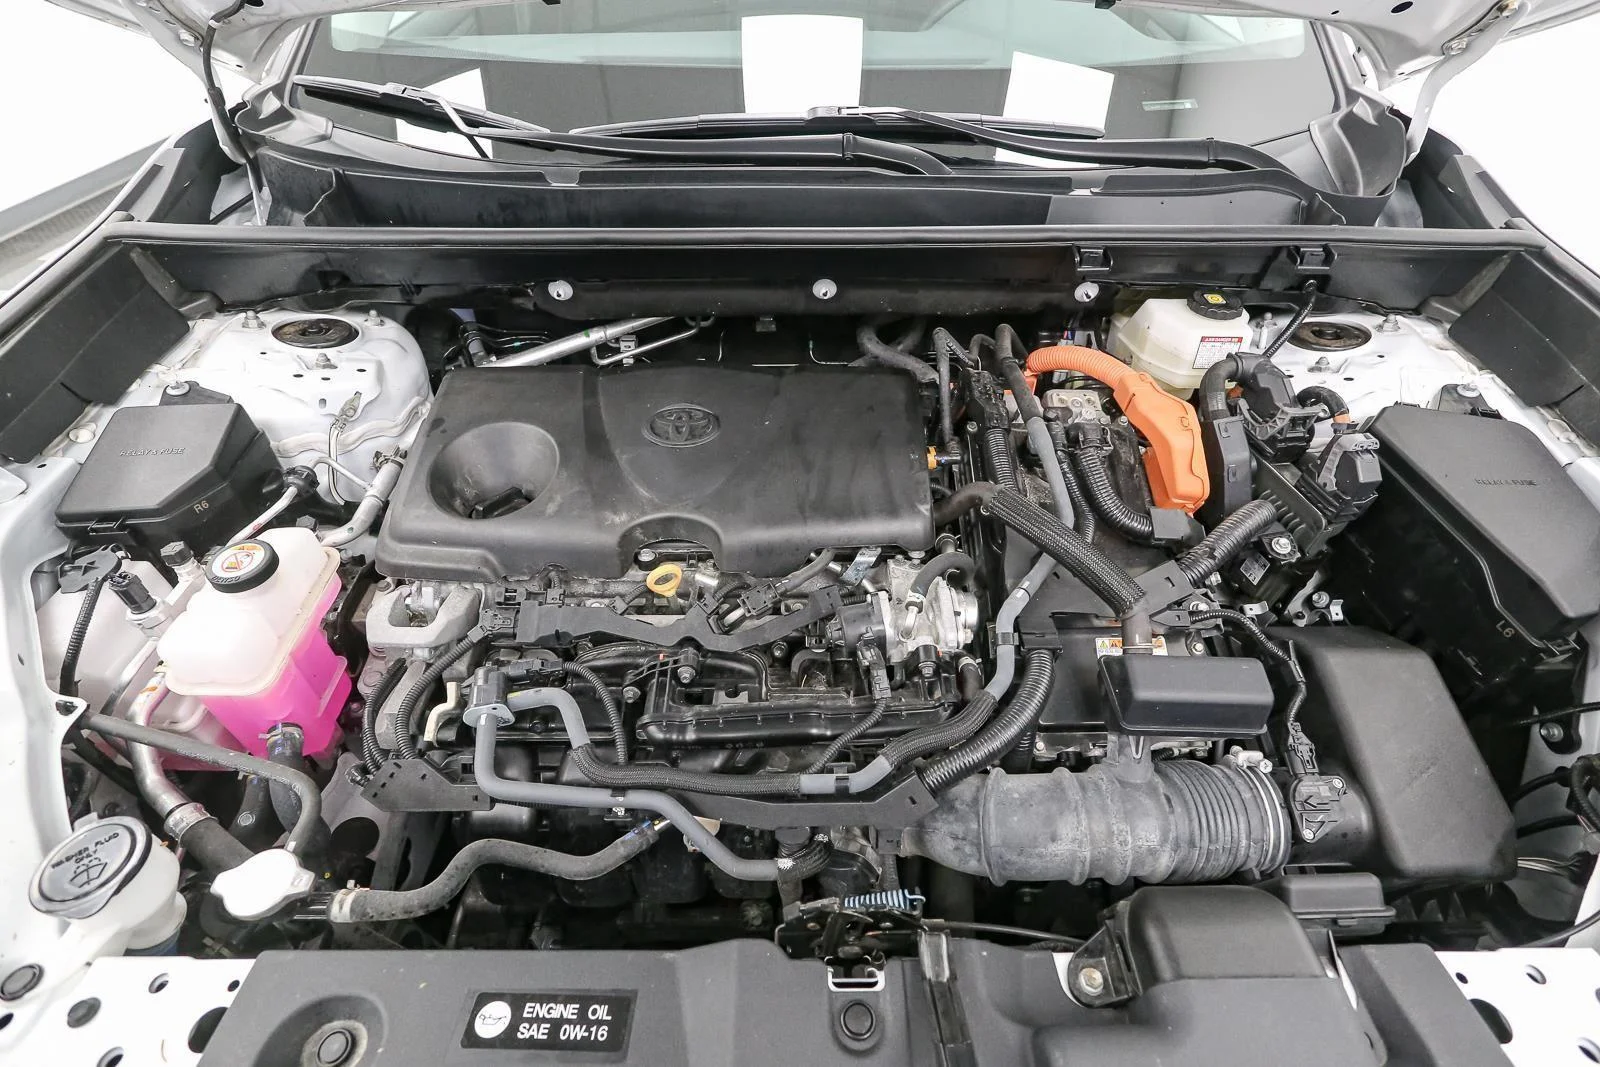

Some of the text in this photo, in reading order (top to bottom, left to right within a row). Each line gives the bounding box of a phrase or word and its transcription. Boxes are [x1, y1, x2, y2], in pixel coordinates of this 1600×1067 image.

[119, 448, 151, 457] RELAY
[160, 447, 186, 455] FUSE
[193, 500, 209, 514] R6
[1495, 619, 1516, 638] L6
[94, 832, 120, 848] FLUID
[74, 848, 98, 865] ONLY
[522, 1003, 613, 1021] ENGINE OIL
[516, 1022, 609, 1042] SAE 0W-16
